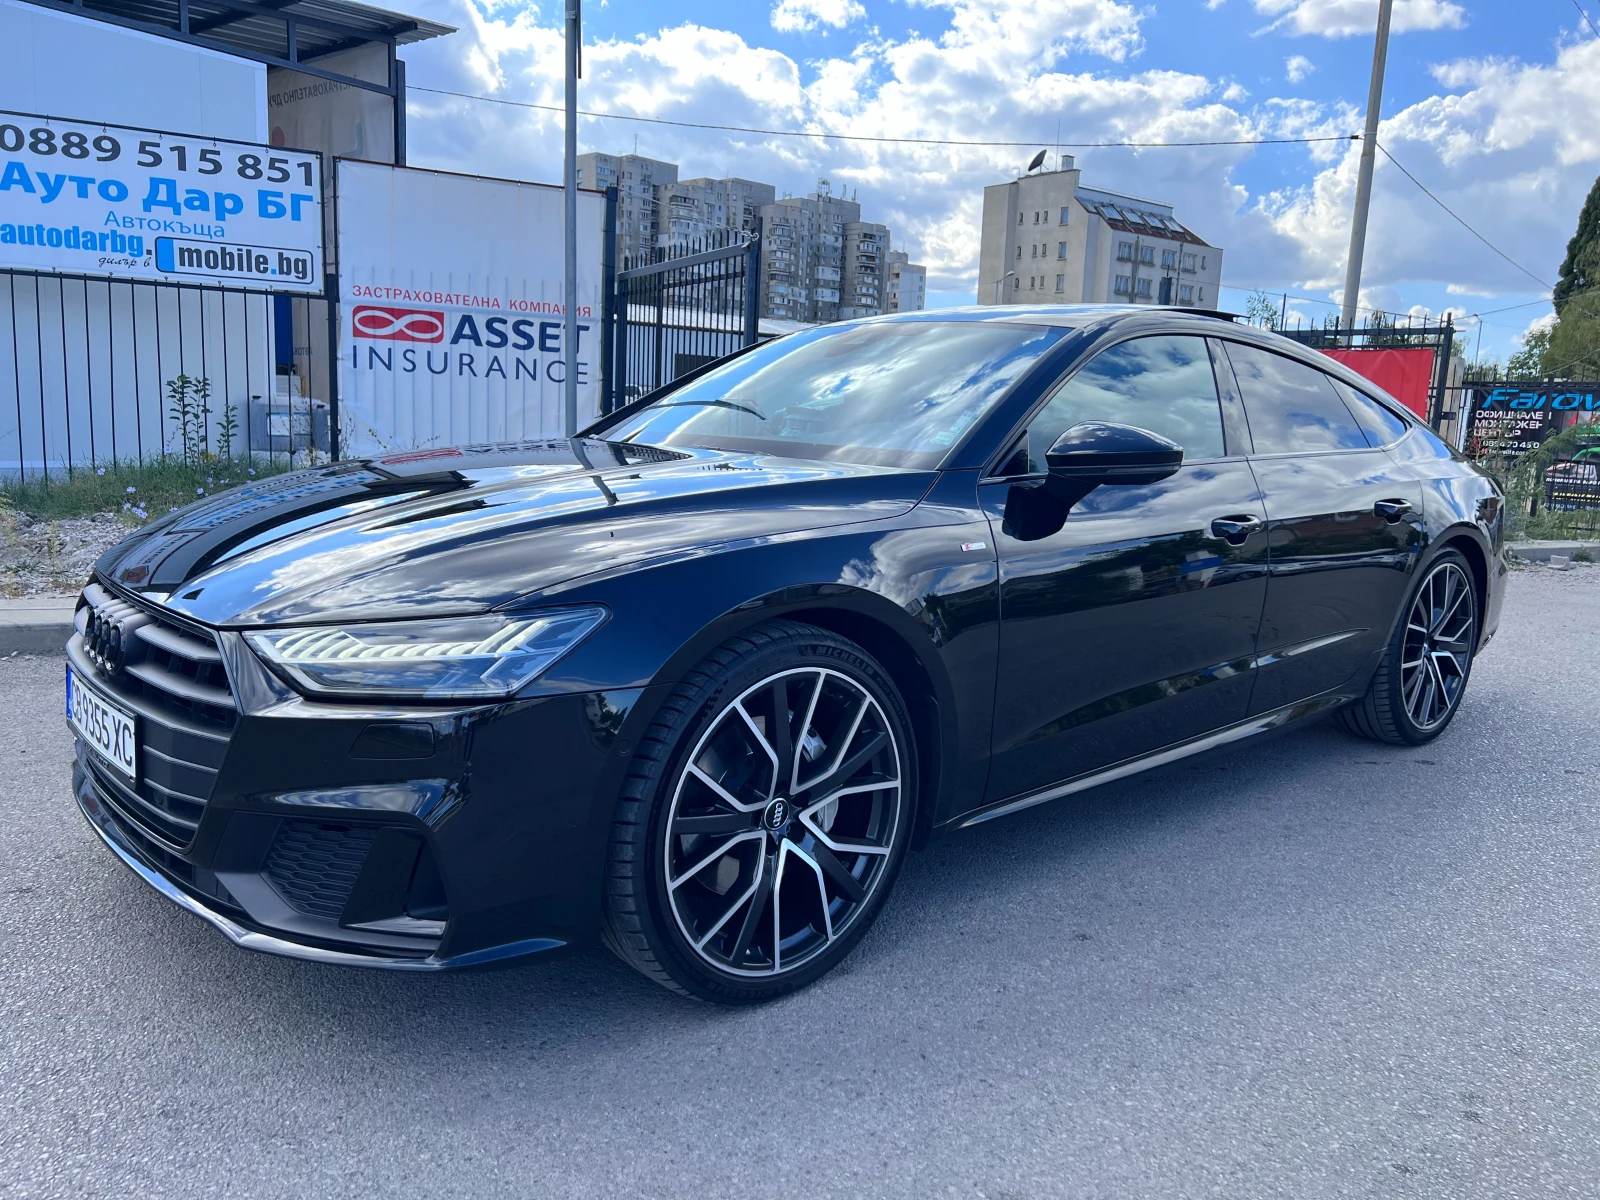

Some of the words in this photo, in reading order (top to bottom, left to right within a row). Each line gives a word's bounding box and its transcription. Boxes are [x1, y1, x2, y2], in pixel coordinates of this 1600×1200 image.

[0, 124, 121, 162] 0889
[136, 140, 223, 175] 515
[237, 154, 313, 187] 851
[0, 161, 128, 204] Ауто
[142, 177, 244, 222] Дар
[257, 189, 314, 222] БГ
[104, 210, 225, 240] Автокъща
[178, 245, 308, 280] mobile.bg
[352, 284, 500, 309] ЗАСТРАХОВАТЕЛНА
[450, 313, 590, 354] ASSET
[352, 345, 589, 385] INSURANCE
[816, 646, 875, 676] MICHELIN
[71, 679, 82, 725] CB
[83, 692, 110, 750] 9355
[112, 714, 133, 768] XC
